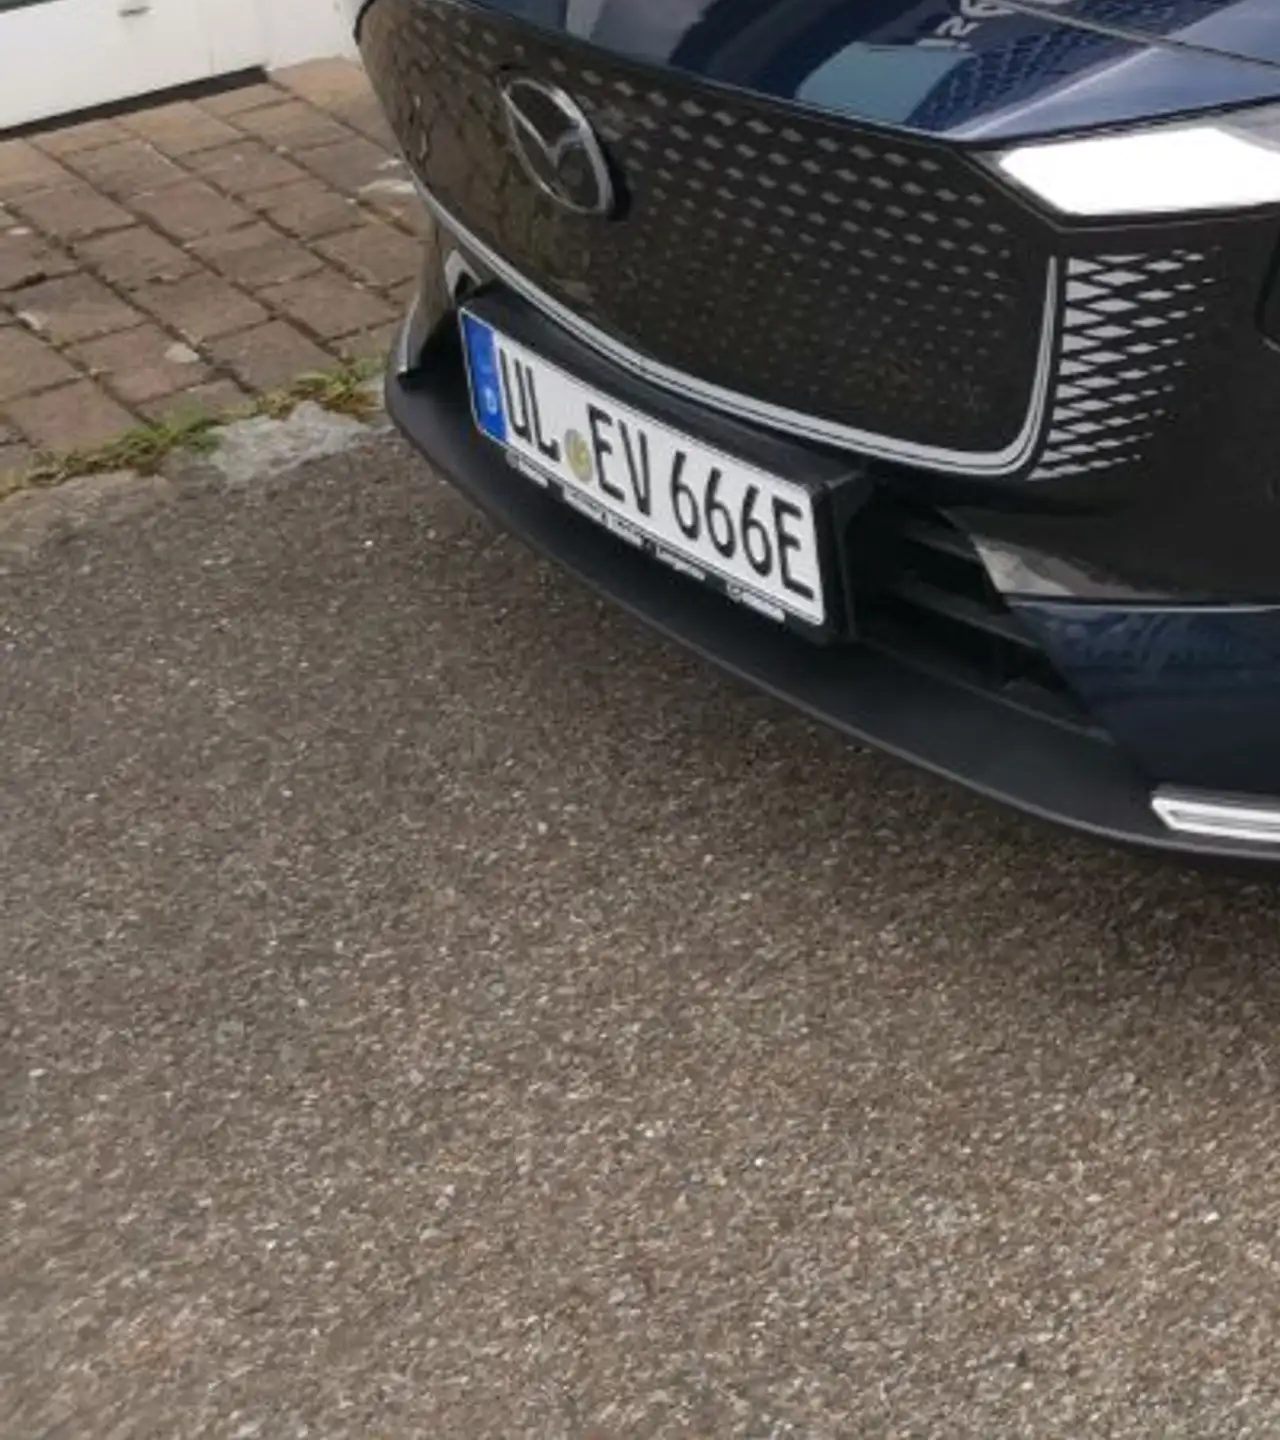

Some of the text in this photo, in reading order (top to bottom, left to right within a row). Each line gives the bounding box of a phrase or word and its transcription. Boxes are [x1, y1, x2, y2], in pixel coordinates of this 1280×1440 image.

[498, 348, 560, 462] UL
[586, 402, 651, 517] EV
[670, 449, 816, 601] 666E
